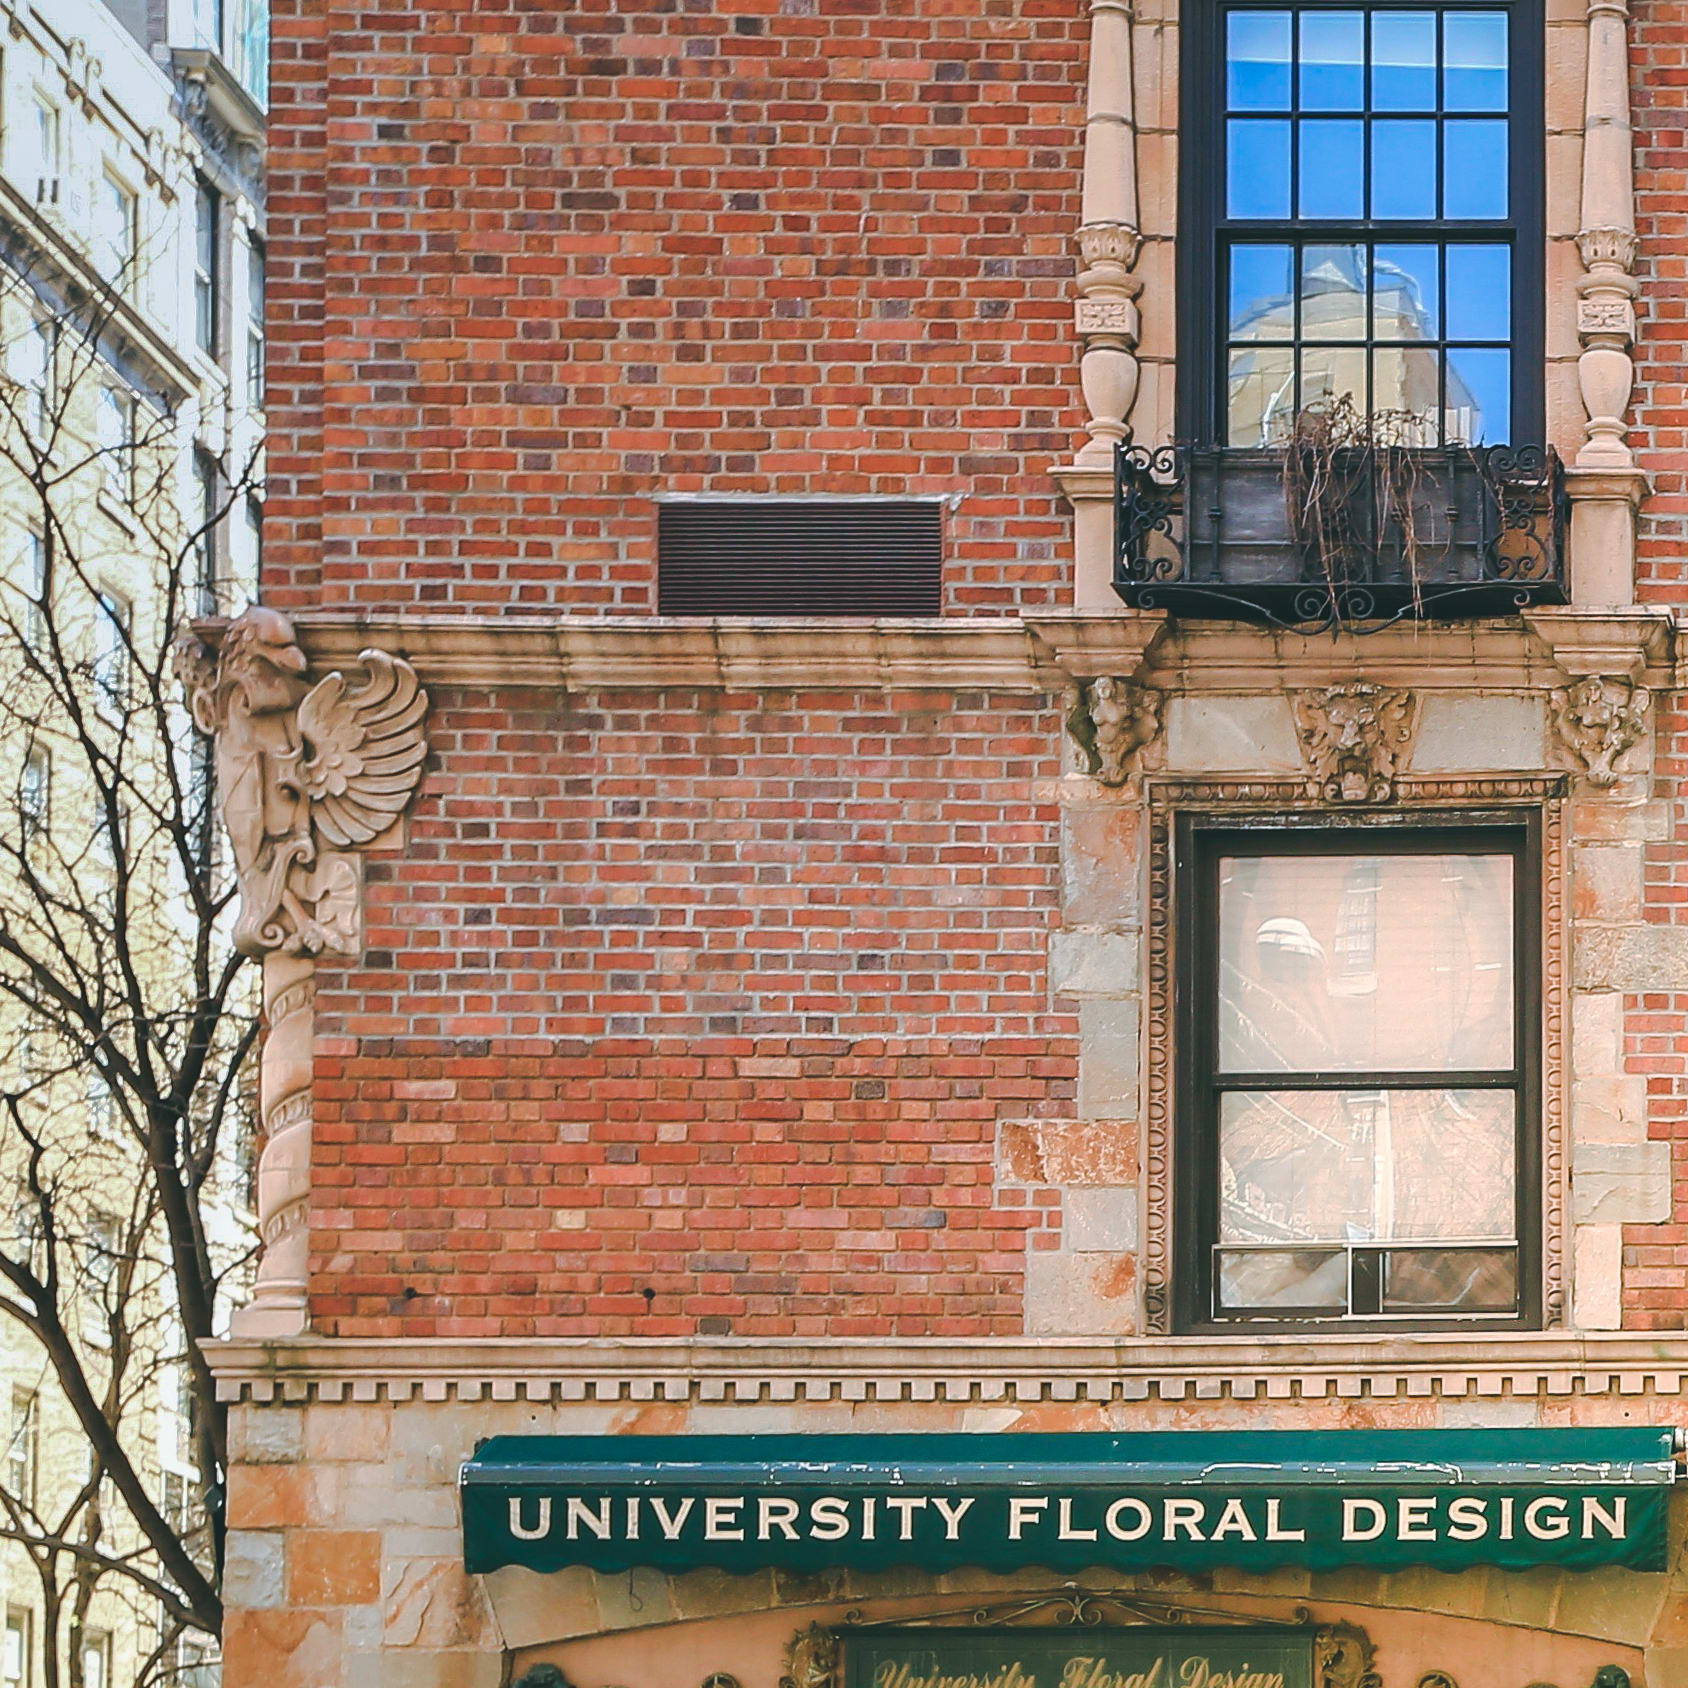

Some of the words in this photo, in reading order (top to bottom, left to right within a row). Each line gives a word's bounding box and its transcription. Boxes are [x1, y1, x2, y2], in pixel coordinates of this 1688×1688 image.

[507, 1496, 976, 1541] UNIVERSITY
[1007, 1496, 1306, 1541] FLORAL
[1342, 1496, 1628, 1541] DESIGN
